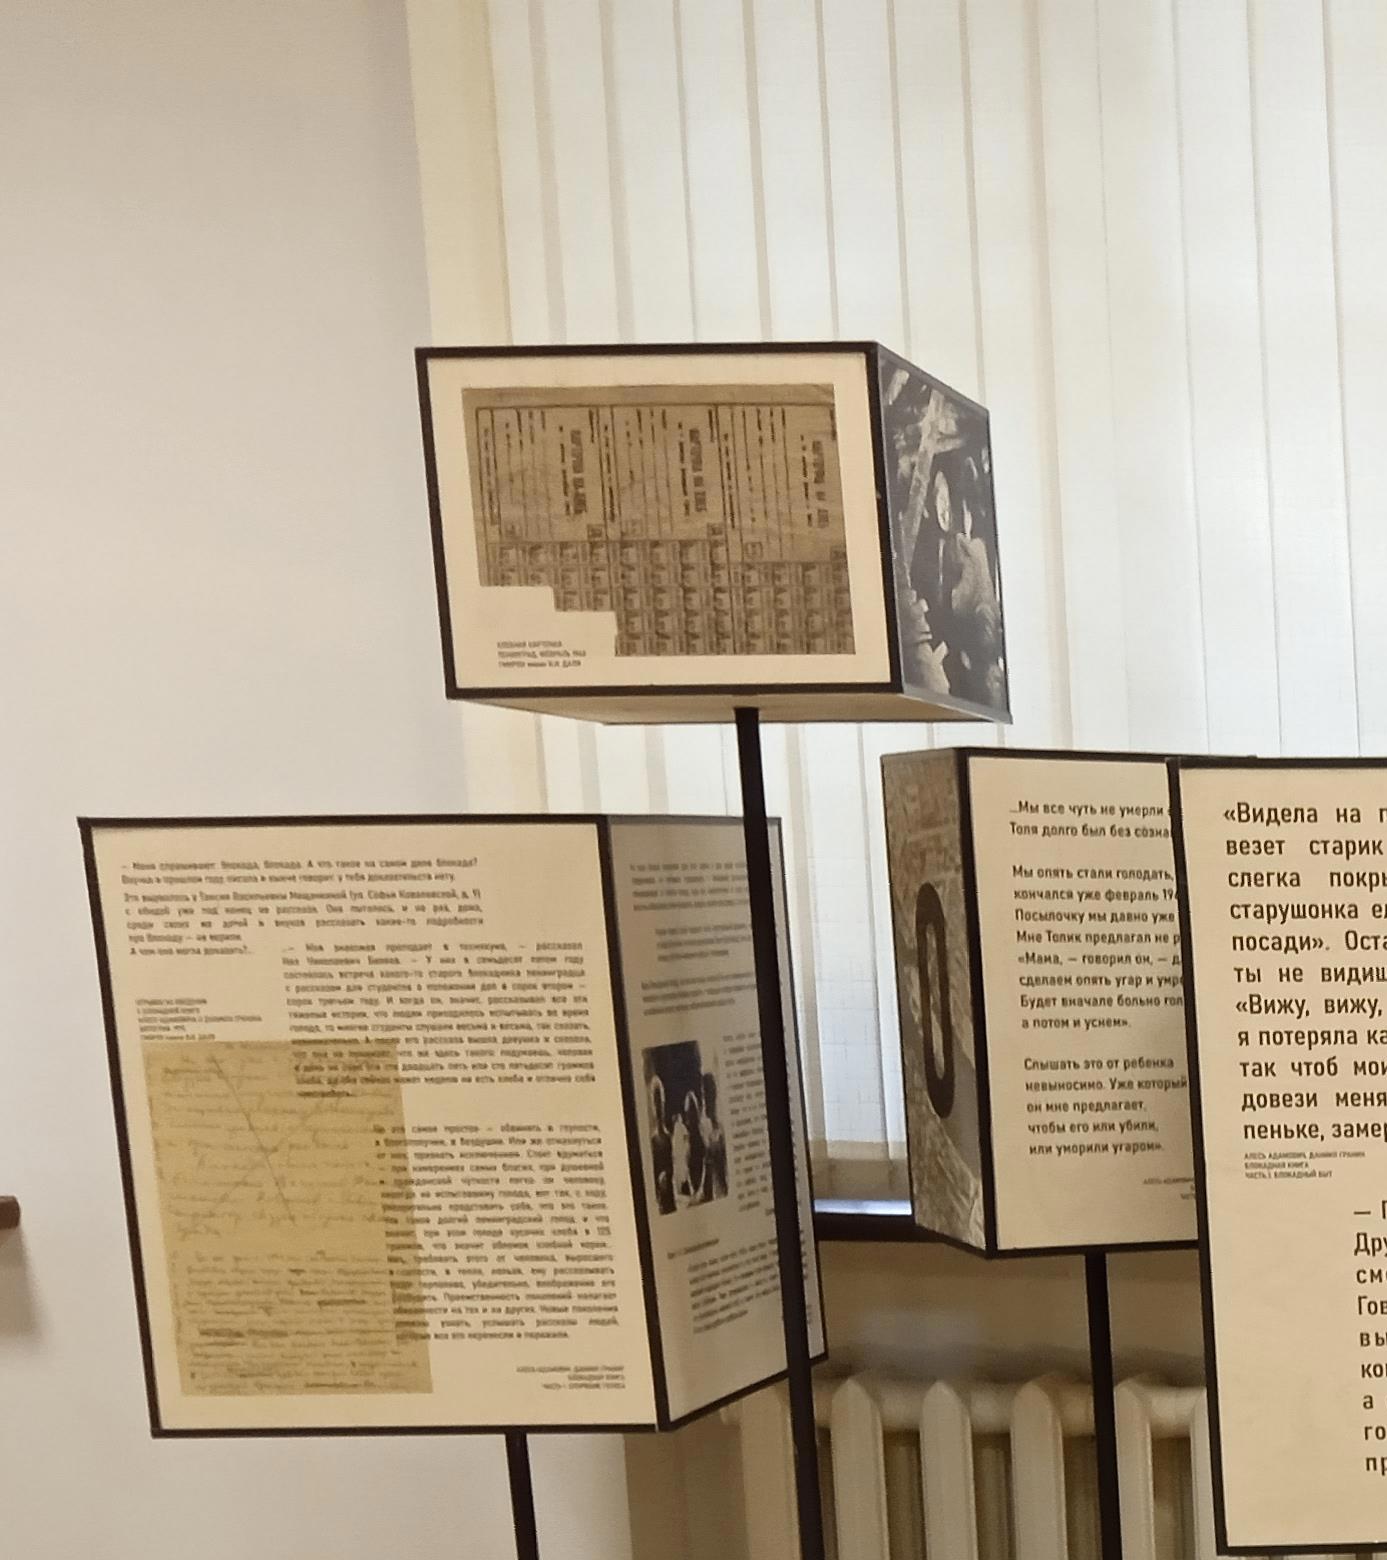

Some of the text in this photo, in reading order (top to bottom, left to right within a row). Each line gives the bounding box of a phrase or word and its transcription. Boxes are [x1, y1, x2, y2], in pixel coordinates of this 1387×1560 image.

[1222, 800, 1318, 827] «Видела
[1335, 806, 1361, 823] на
[1225, 838, 1285, 856] везет
[1308, 838, 1384, 861] старик
[1227, 870, 1301, 888] слегка
[1229, 902, 1359, 925] старушонка
[1231, 934, 1330, 955] посади».
